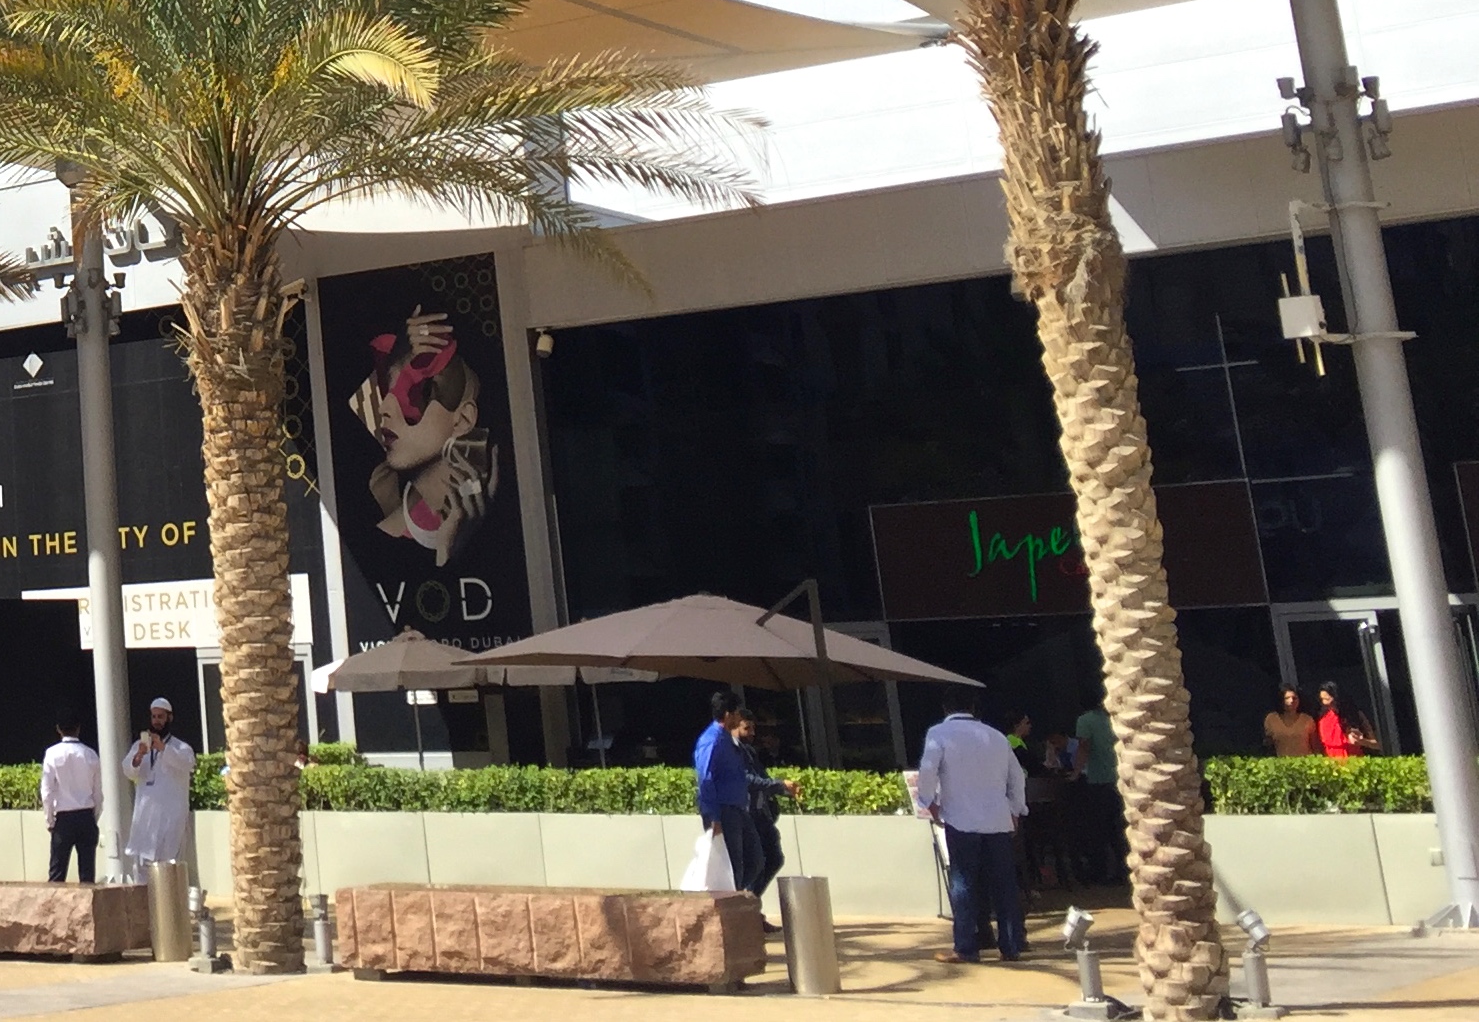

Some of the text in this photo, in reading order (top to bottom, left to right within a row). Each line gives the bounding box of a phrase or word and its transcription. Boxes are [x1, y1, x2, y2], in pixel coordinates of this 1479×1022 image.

[28, 530, 78, 557] THE
[118, 525, 149, 550] TY
[161, 520, 197, 547] OF
[968, 510, 1082, 602] Jape
[375, 577, 493, 624] VOD
[133, 620, 191, 641] DESK
